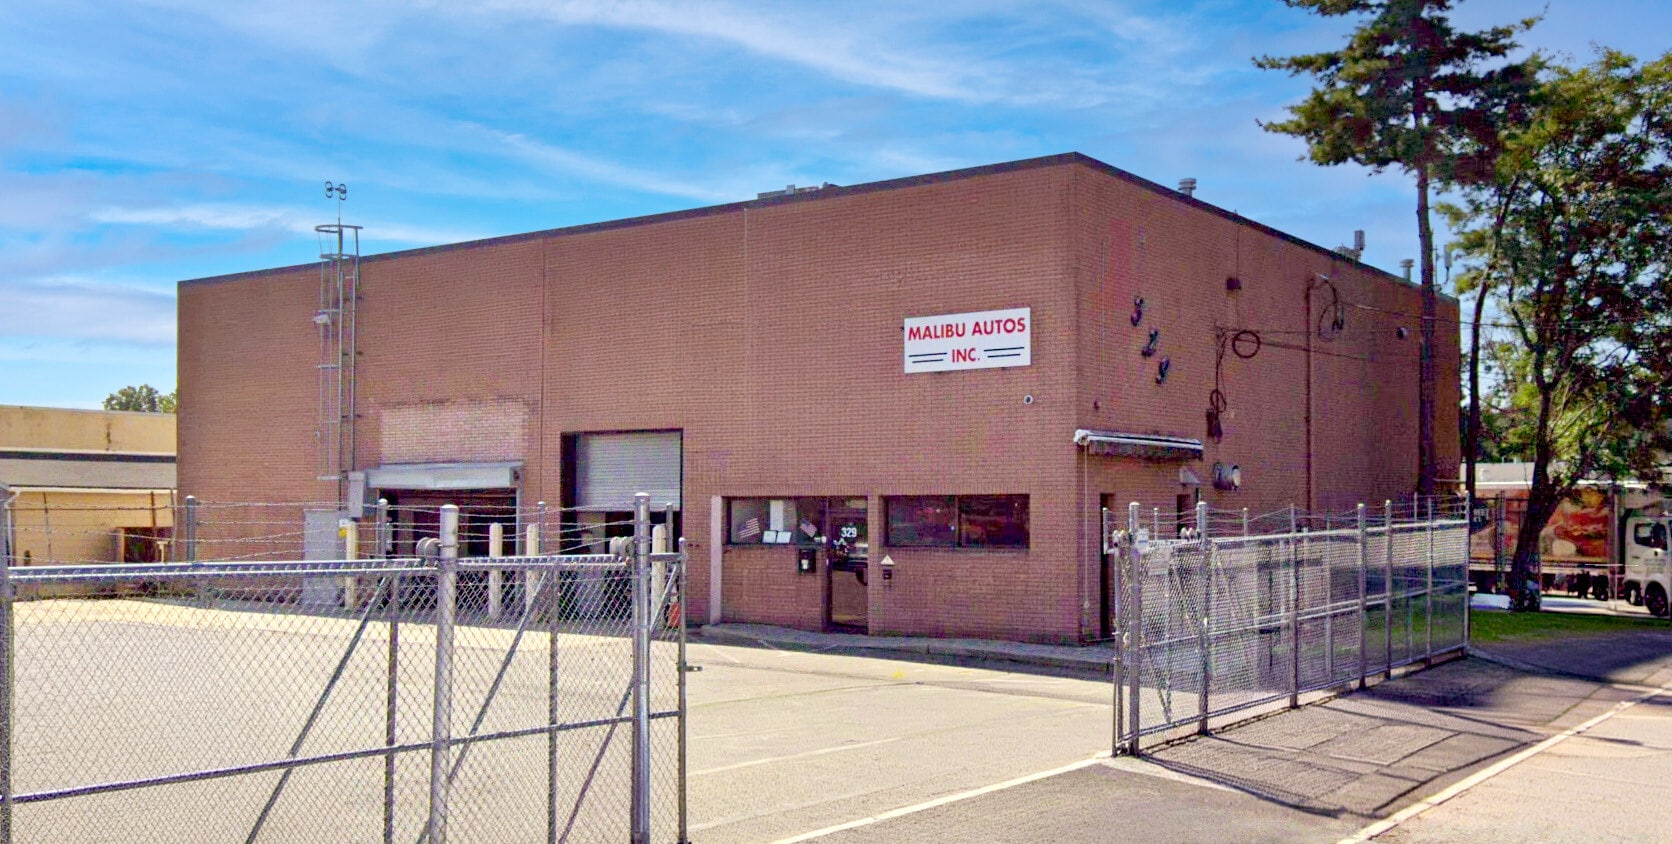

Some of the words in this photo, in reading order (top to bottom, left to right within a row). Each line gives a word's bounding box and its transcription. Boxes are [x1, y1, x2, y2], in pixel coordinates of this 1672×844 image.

[908, 322, 966, 341] MALIBU
[972, 317, 1026, 336] AUTOS
[951, 347, 980, 363] INC.
[840, 526, 857, 538] 329
